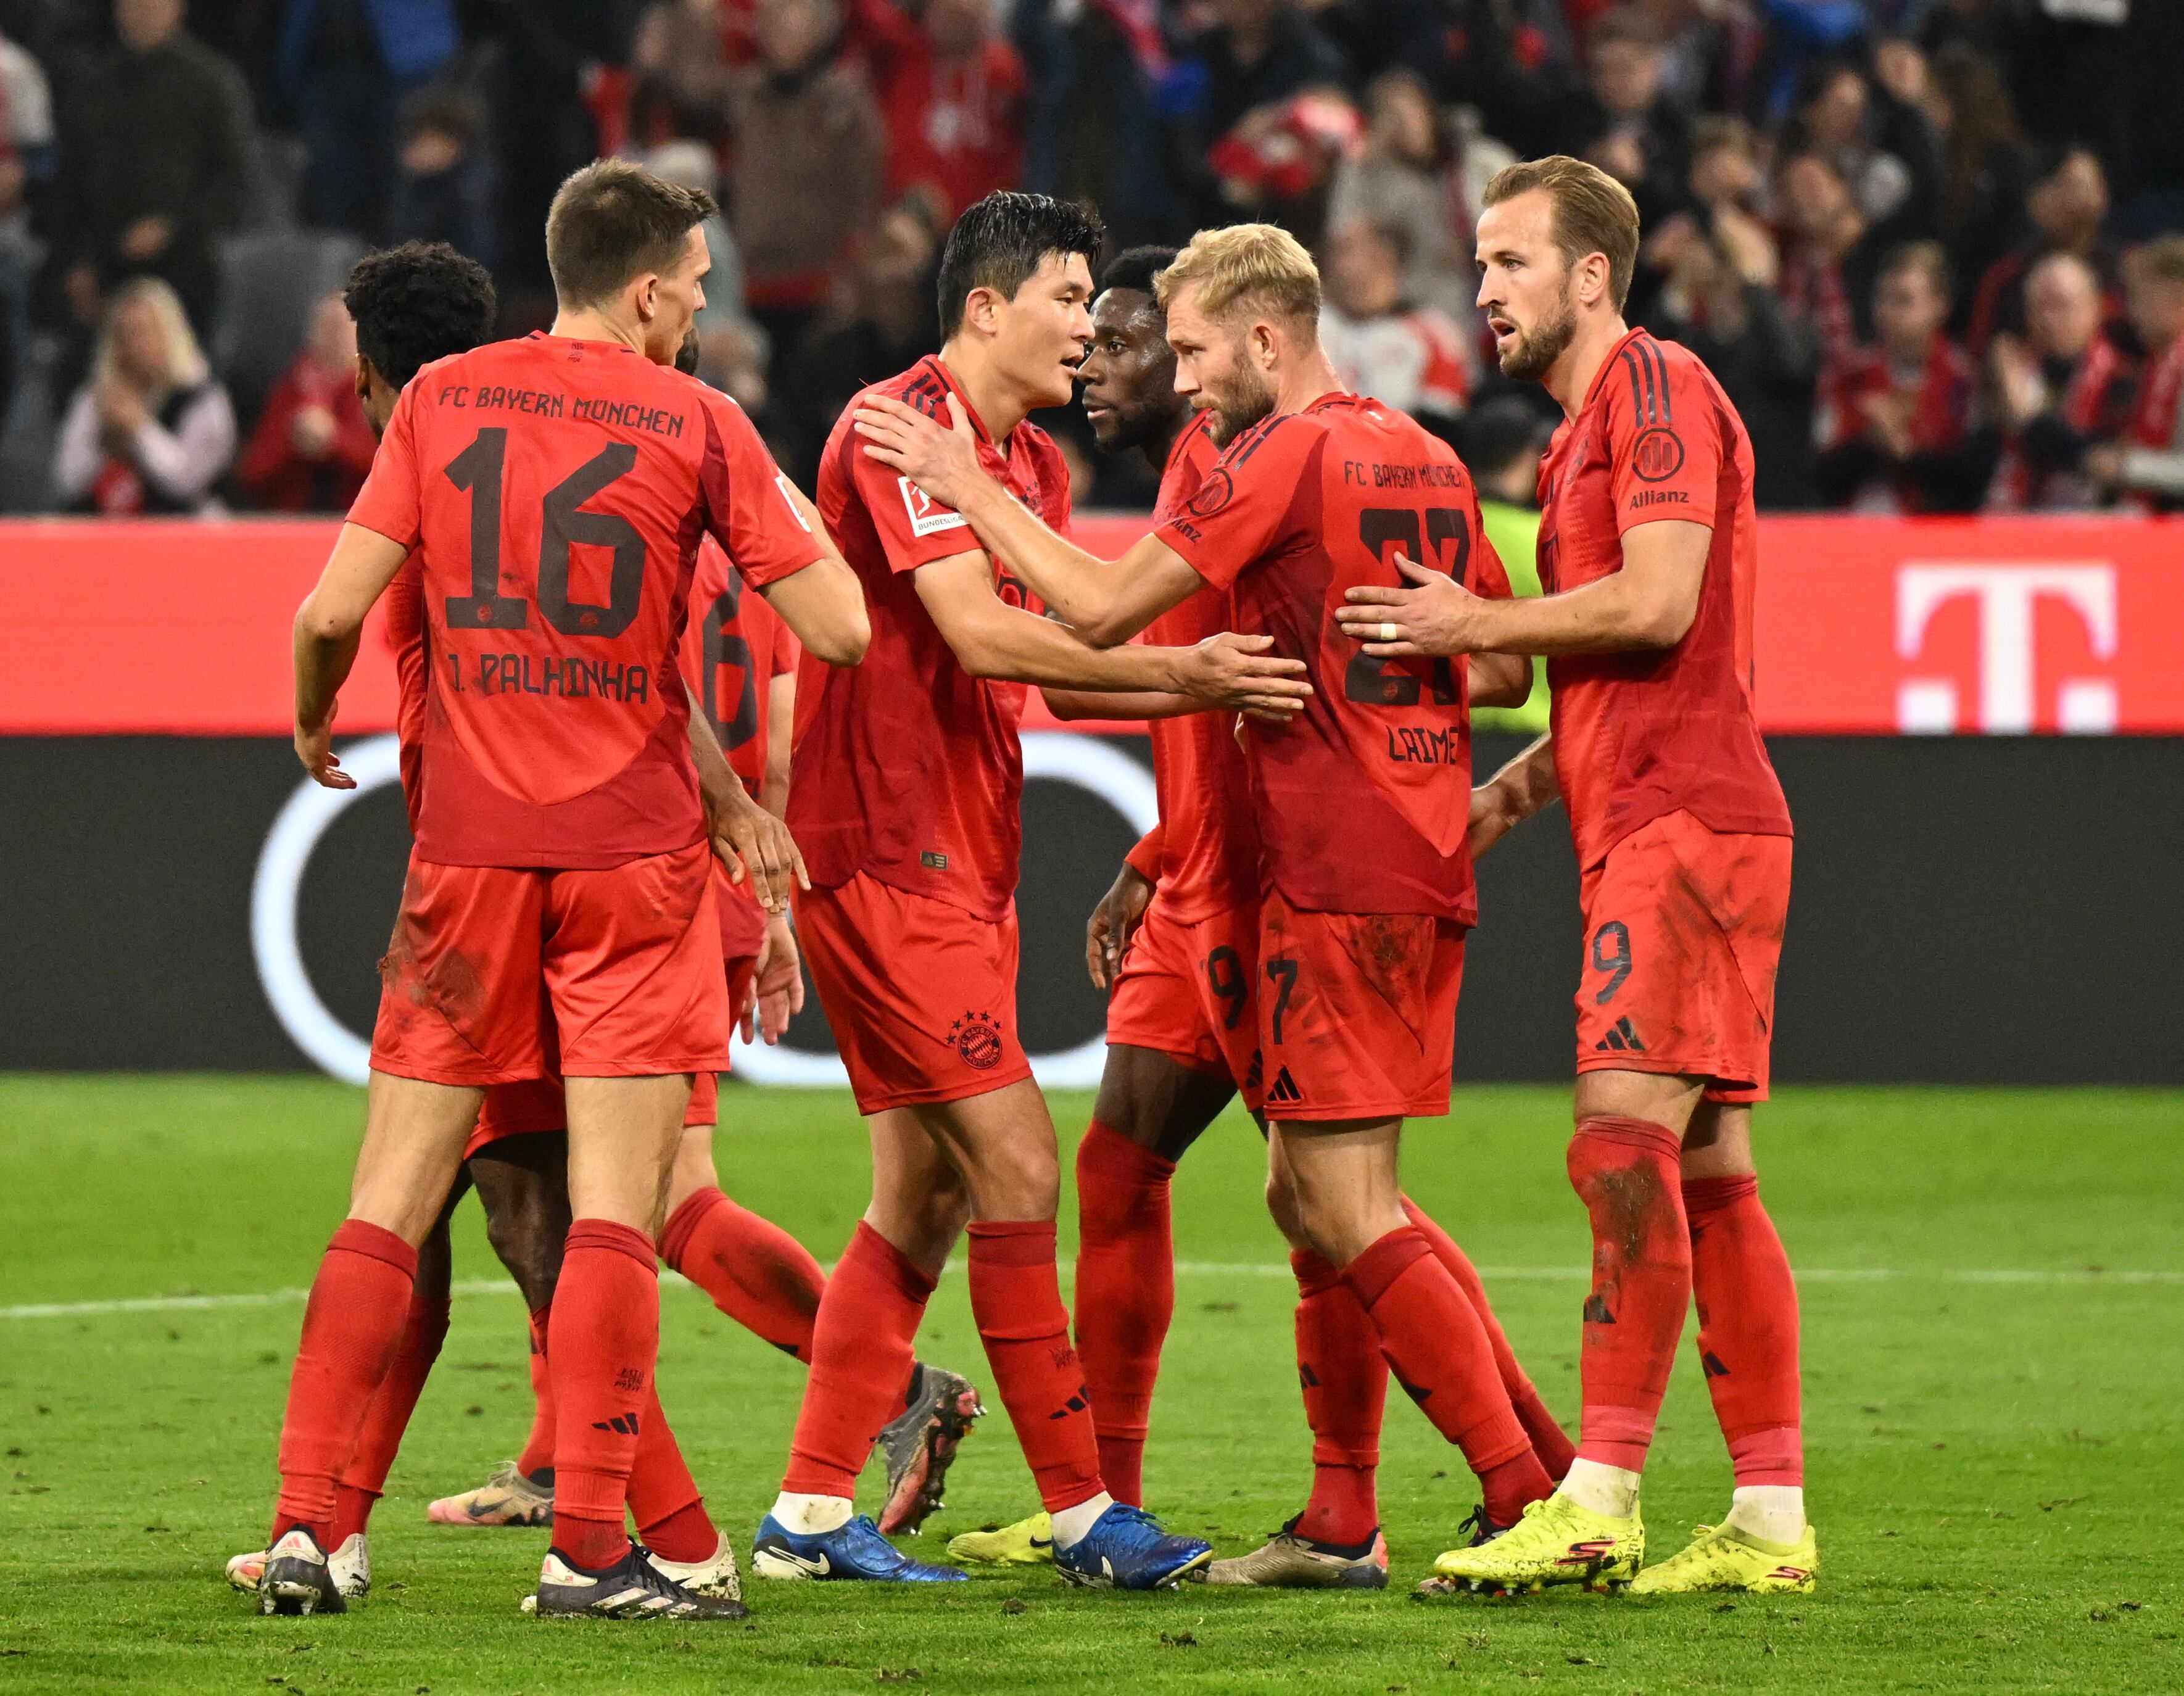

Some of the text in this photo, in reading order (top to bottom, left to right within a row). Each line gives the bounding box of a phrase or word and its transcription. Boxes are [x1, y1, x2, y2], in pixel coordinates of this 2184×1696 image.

[439, 387, 684, 439] FC BAYERN MÜNCHEN
[1344, 461, 1367, 486] FC
[1372, 464, 1418, 489] BAYERN
[1629, 490, 1689, 511] Allianz
[443, 427, 647, 639] 16
[918, 516, 963, 530] BUNDESLIGA
[1895, 563, 2116, 734] T
[480, 653, 647, 704] PALHINHA
[1384, 724, 1459, 765] LAIME
[1199, 945, 1249, 1030] 9
[1592, 920, 1632, 1005] 9
[1257, 960, 1298, 1044] 7
